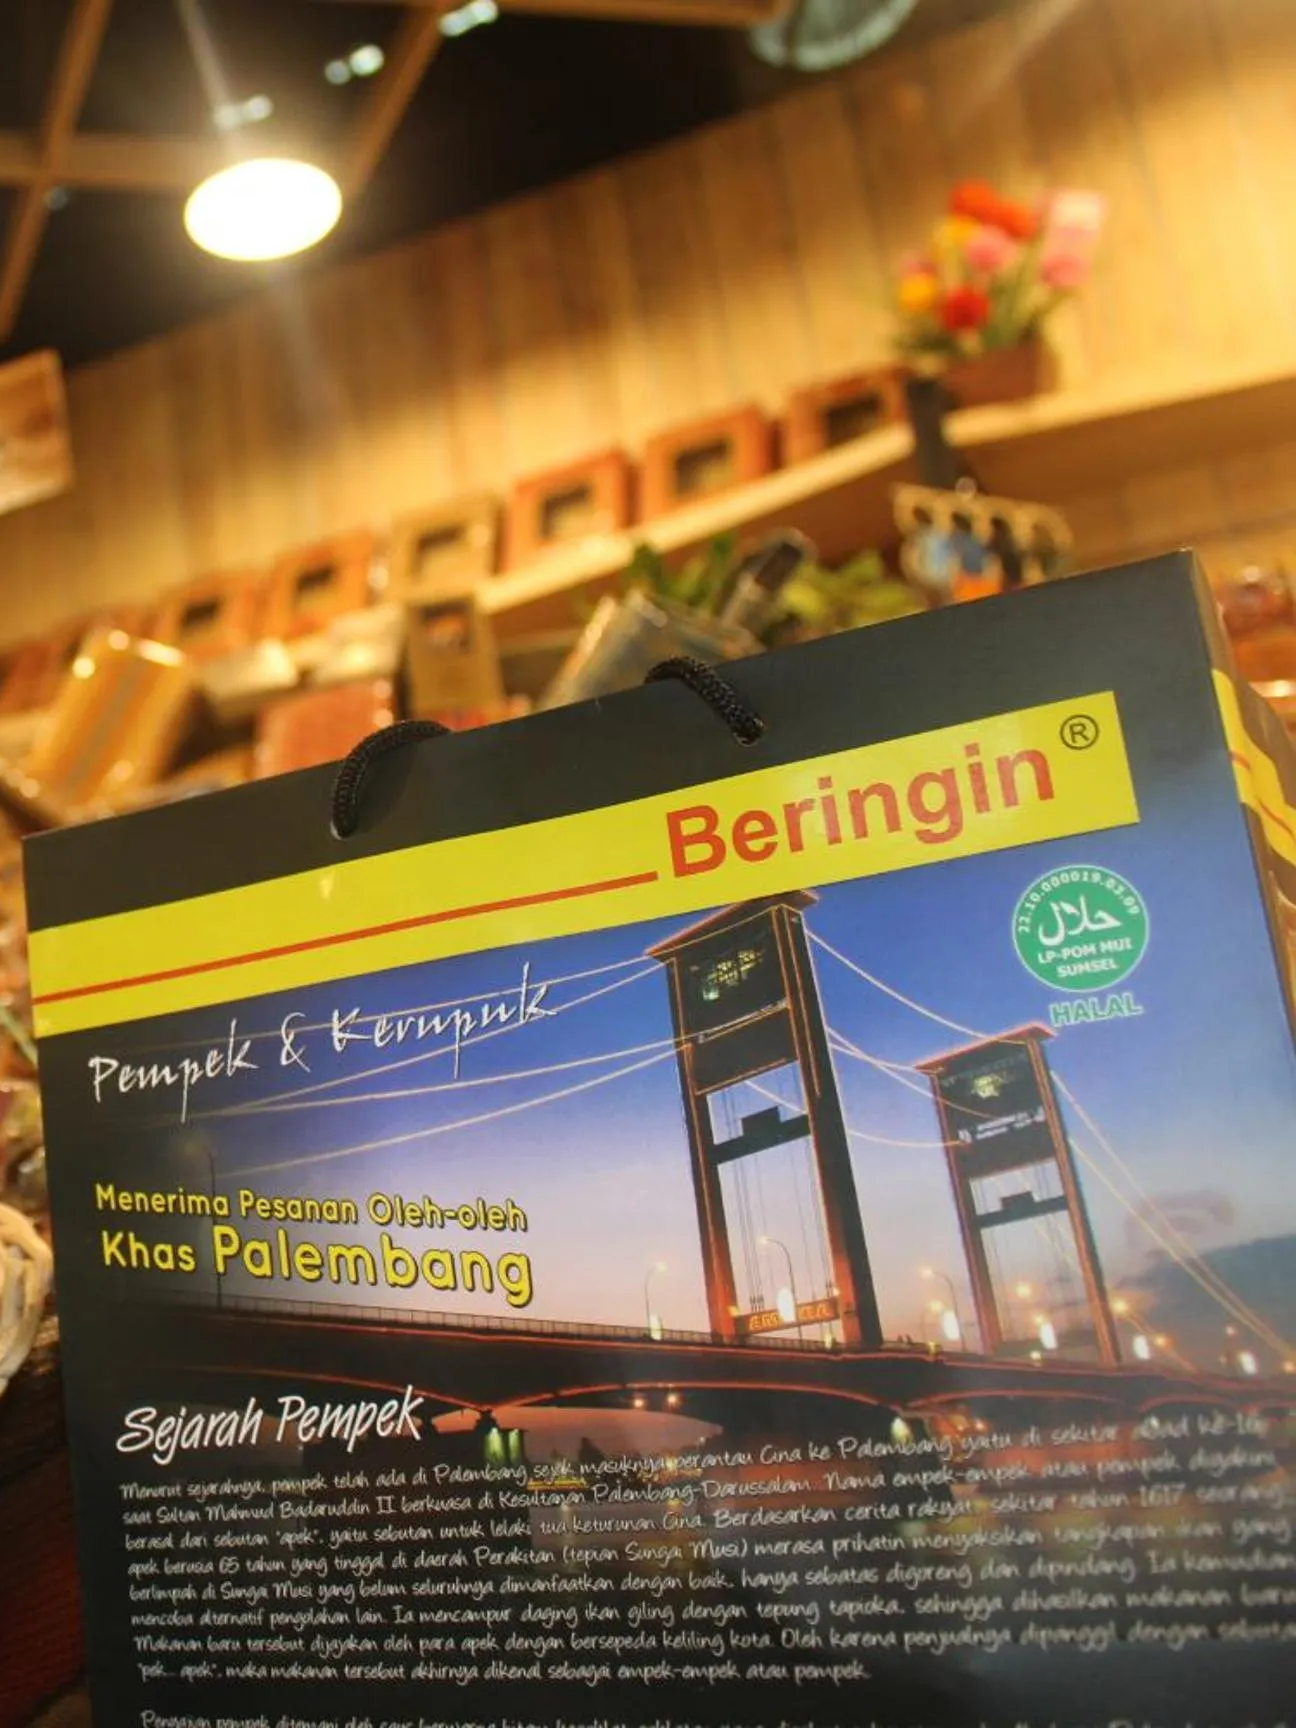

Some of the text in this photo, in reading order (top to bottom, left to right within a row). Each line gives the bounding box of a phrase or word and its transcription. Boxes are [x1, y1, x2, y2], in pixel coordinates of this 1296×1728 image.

[666, 743, 1055, 879] Beringin
[1037, 894, 1123, 946] حلال
[1037, 937, 1133, 964] LP-POM MUI
[1056, 957, 1119, 978] SUMSEL
[1048, 991, 1144, 1028] HALAL
[89, 962, 559, 1124] Pempek & Kerupuk
[94, 1183, 529, 1232] Menerima Pesanan Oleh-oleh
[100, 1225, 534, 1308] Khas Palembang
[115, 1385, 423, 1466] Sejarah Pempek
[119, 1481, 182, 1499] Menurut
[272, 1472, 327, 1497] pempek
[334, 1470, 370, 1489] telah
[376, 1468, 406, 1487] ada
[412, 1466, 429, 1485] di
[433, 1462, 528, 1487] Palembang
[673, 1448, 754, 1471] perantau
[759, 1443, 802, 1465] Cina
[807, 1441, 832, 1461] ke
[1021, 1424, 1042, 1448] di
[122, 1506, 152, 1525] saat
[156, 1503, 202, 1524] Sultan
[206, 1502, 274, 1523] Mahmud
[279, 1500, 370, 1521] Badaruddin
[376, 1495, 396, 1515] II
[401, 1494, 472, 1514] berkuasa
[477, 1493, 495, 1511] di
[498, 1488, 585, 1510] Kesultanan
[824, 1471, 887, 1492] Nama
[213, 1529, 269, 1547] sebutan
[328, 1526, 370, 1549] yaitu
[373, 1523, 433, 1542] sebutan
[439, 1518, 485, 1539] untuk
[490, 1516, 532, 1537] lelaki
[539, 1518, 568, 1534] tua
[572, 1513, 656, 1533] keturunan
[714, 1505, 838, 1529] Berdasarkan
[843, 1501, 900, 1522] cerita
[128, 1559, 159, 1580] apek
[164, 1557, 214, 1576] berusia
[218, 1556, 240, 1574] 65
[246, 1555, 285, 1573] tahun
[291, 1555, 328, 1577] yang
[334, 1552, 384, 1577] tinggal
[392, 1550, 408, 1569] di
[414, 1548, 468, 1569] daerah
[692, 1537, 748, 1562] Musi)
[754, 1535, 825, 1557] merasa
[831, 1531, 905, 1561] prihatin
[202, 1581, 216, 1600] di
[273, 1579, 313, 1599] Musi
[318, 1581, 355, 1604] yang
[359, 1578, 406, 1597] belum
[412, 1576, 494, 1600] seluruhnya
[500, 1573, 614, 1592] dimanfaatkan
[620, 1572, 683, 1597] dengan
[740, 1567, 799, 1594] hanya
[804, 1565, 880, 1586] sebatas
[885, 1561, 973, 1591] digoreng
[131, 1609, 193, 1627] mencoba
[199, 1607, 264, 1625] alternatif
[270, 1606, 350, 1632] pengolahan
[393, 1603, 414, 1624] Ia
[419, 1605, 512, 1629] mencampur
[520, 1602, 579, 1629] daging
[585, 1600, 620, 1621] ikan
[627, 1600, 675, 1628] giling
[682, 1599, 747, 1627] dengan
[756, 1599, 821, 1626] tepung
[134, 1634, 203, 1652] Makanan
[207, 1633, 241, 1651] baru
[246, 1634, 305, 1652] tersebut
[383, 1632, 414, 1651] oleh
[418, 1635, 455, 1657] para
[460, 1632, 500, 1657] apek
[504, 1631, 565, 1659] dengan
[571, 1630, 657, 1657] bersepeda
[662, 1628, 725, 1657] keliling
[781, 1626, 823, 1649] Oleh
[829, 1626, 897, 1648] karena
[226, 1661, 268, 1679] maka
[271, 1661, 339, 1679] makanan
[345, 1660, 406, 1679] tersebut
[410, 1660, 479, 1687] akhirnya
[484, 1659, 542, 1680] dikenal
[547, 1659, 611, 1688] sebagai
[617, 1658, 741, 1686] empek-empek
[746, 1662, 789, 1680] atau
